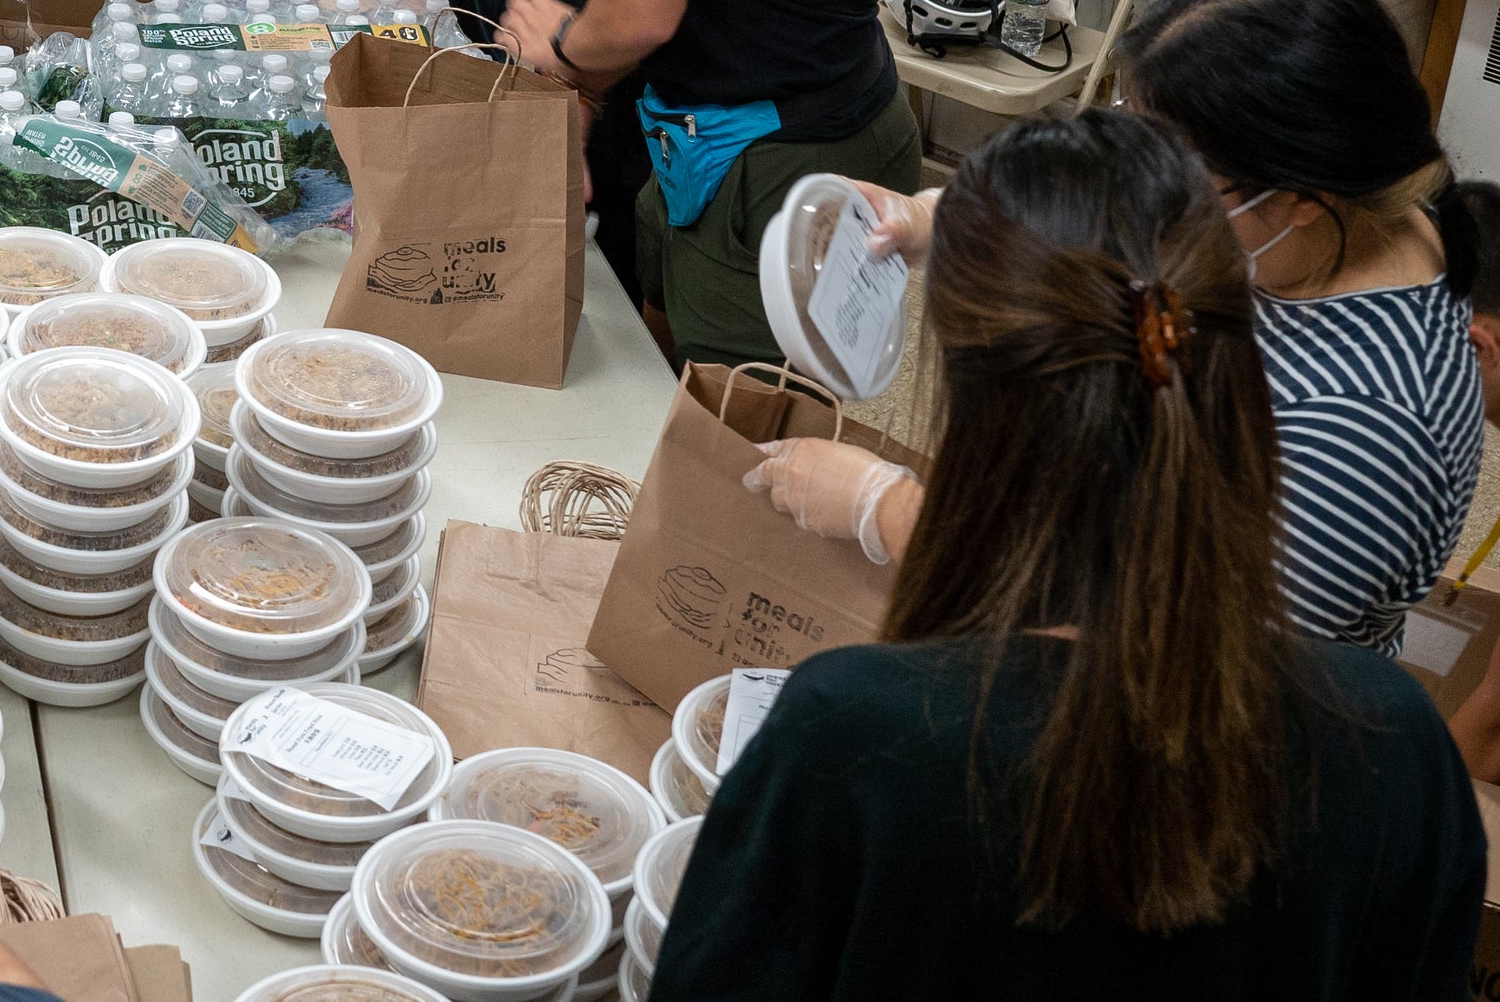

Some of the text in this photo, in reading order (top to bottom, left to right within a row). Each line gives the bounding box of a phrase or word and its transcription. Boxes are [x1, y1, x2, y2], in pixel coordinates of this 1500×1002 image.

[169, 26, 232, 38] Poland
[173, 33, 238, 46] Spring
[199, 129, 282, 175] oland
[233, 186, 255, 199] 845
[443, 237, 507, 256] meals
[366, 287, 429, 305] mealsforunity.org
[747, 591, 825, 643] meals
[535, 685, 611, 703] mealsforunity.org
